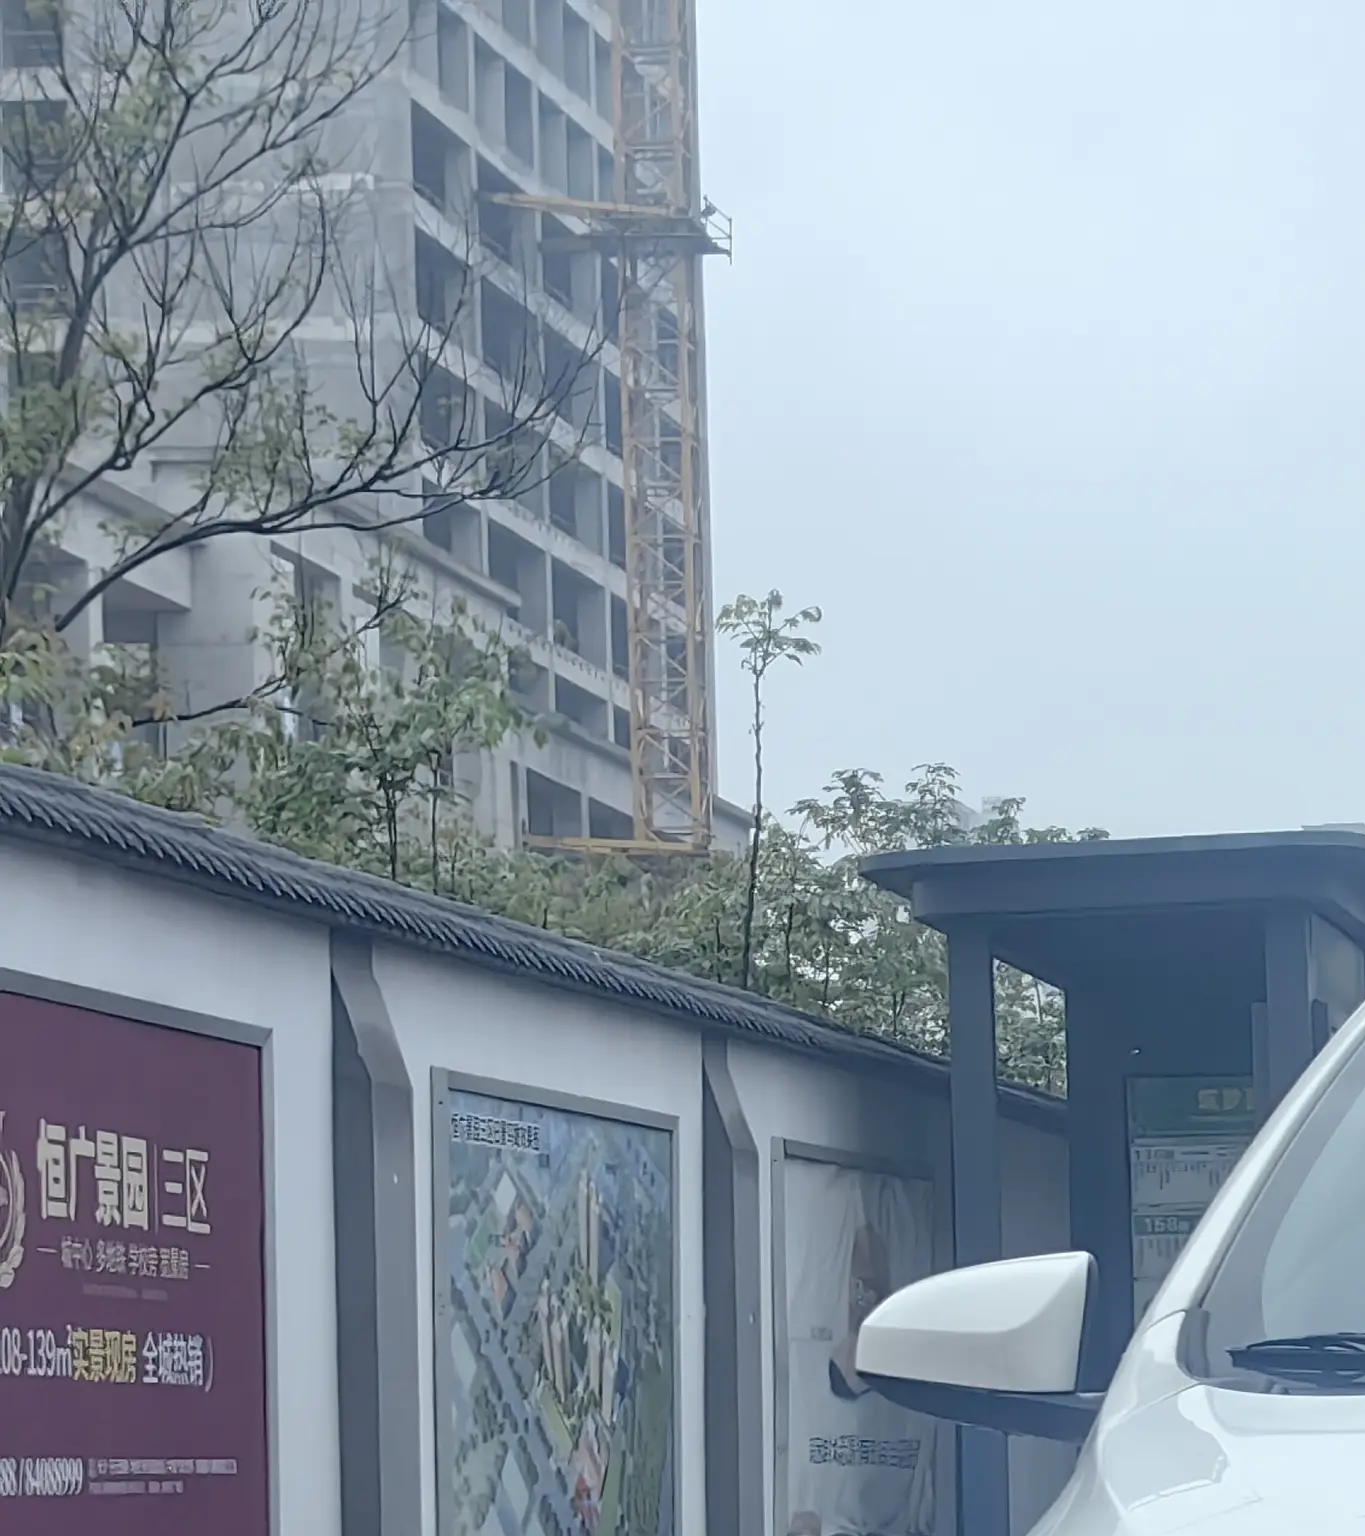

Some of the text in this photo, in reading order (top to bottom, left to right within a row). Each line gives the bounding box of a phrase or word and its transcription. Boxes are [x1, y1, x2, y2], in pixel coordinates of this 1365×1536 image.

[36, 1118, 211, 1234] 恒广景园 三区
